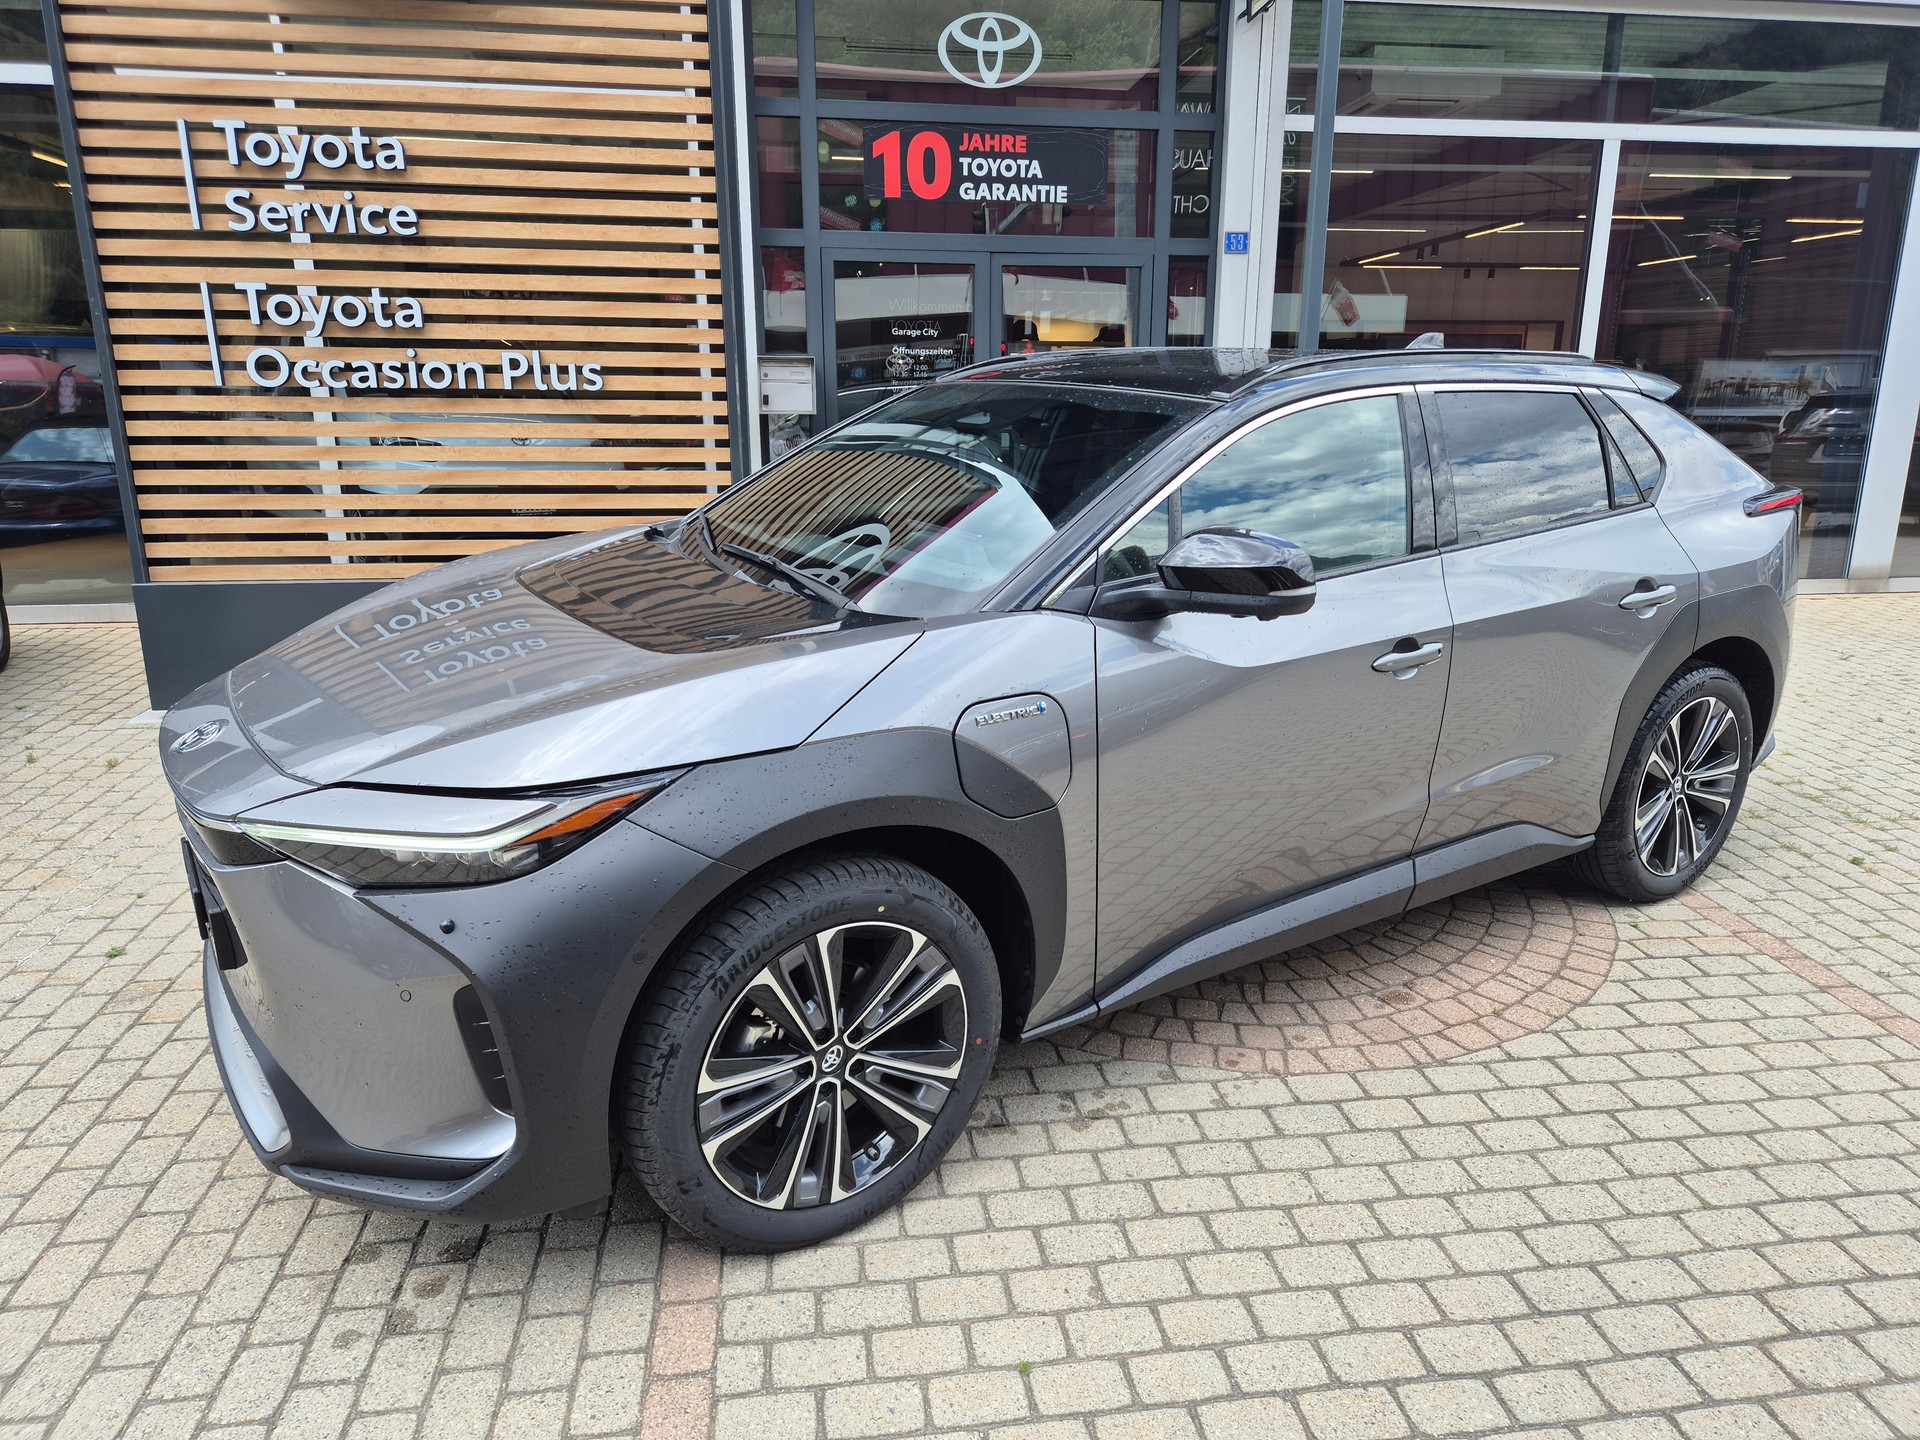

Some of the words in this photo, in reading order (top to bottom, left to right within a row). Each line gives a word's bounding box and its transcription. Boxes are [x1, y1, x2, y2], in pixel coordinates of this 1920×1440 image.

[213, 119, 406, 180] Toyota
[959, 132, 1028, 154] JAHRE
[872, 130, 952, 201] 10
[959, 157, 1043, 179] TOYOTA
[959, 182, 1068, 204] GARANTIE
[225, 189, 420, 236] Service
[1230, 234, 1244, 251] 53
[234, 282, 425, 338] Toyota
[888, 298, 962, 313] Willkommen
[891, 328, 921, 338] Garage
[922, 328, 939, 338] City
[892, 345, 953, 357] Öffnungszeiten
[246, 347, 487, 390] Occasion
[500, 350, 604, 391] Plus
[975, 704, 1041, 728] ELECTRIC
[711, 896, 851, 1001] BRIDGESTONE
